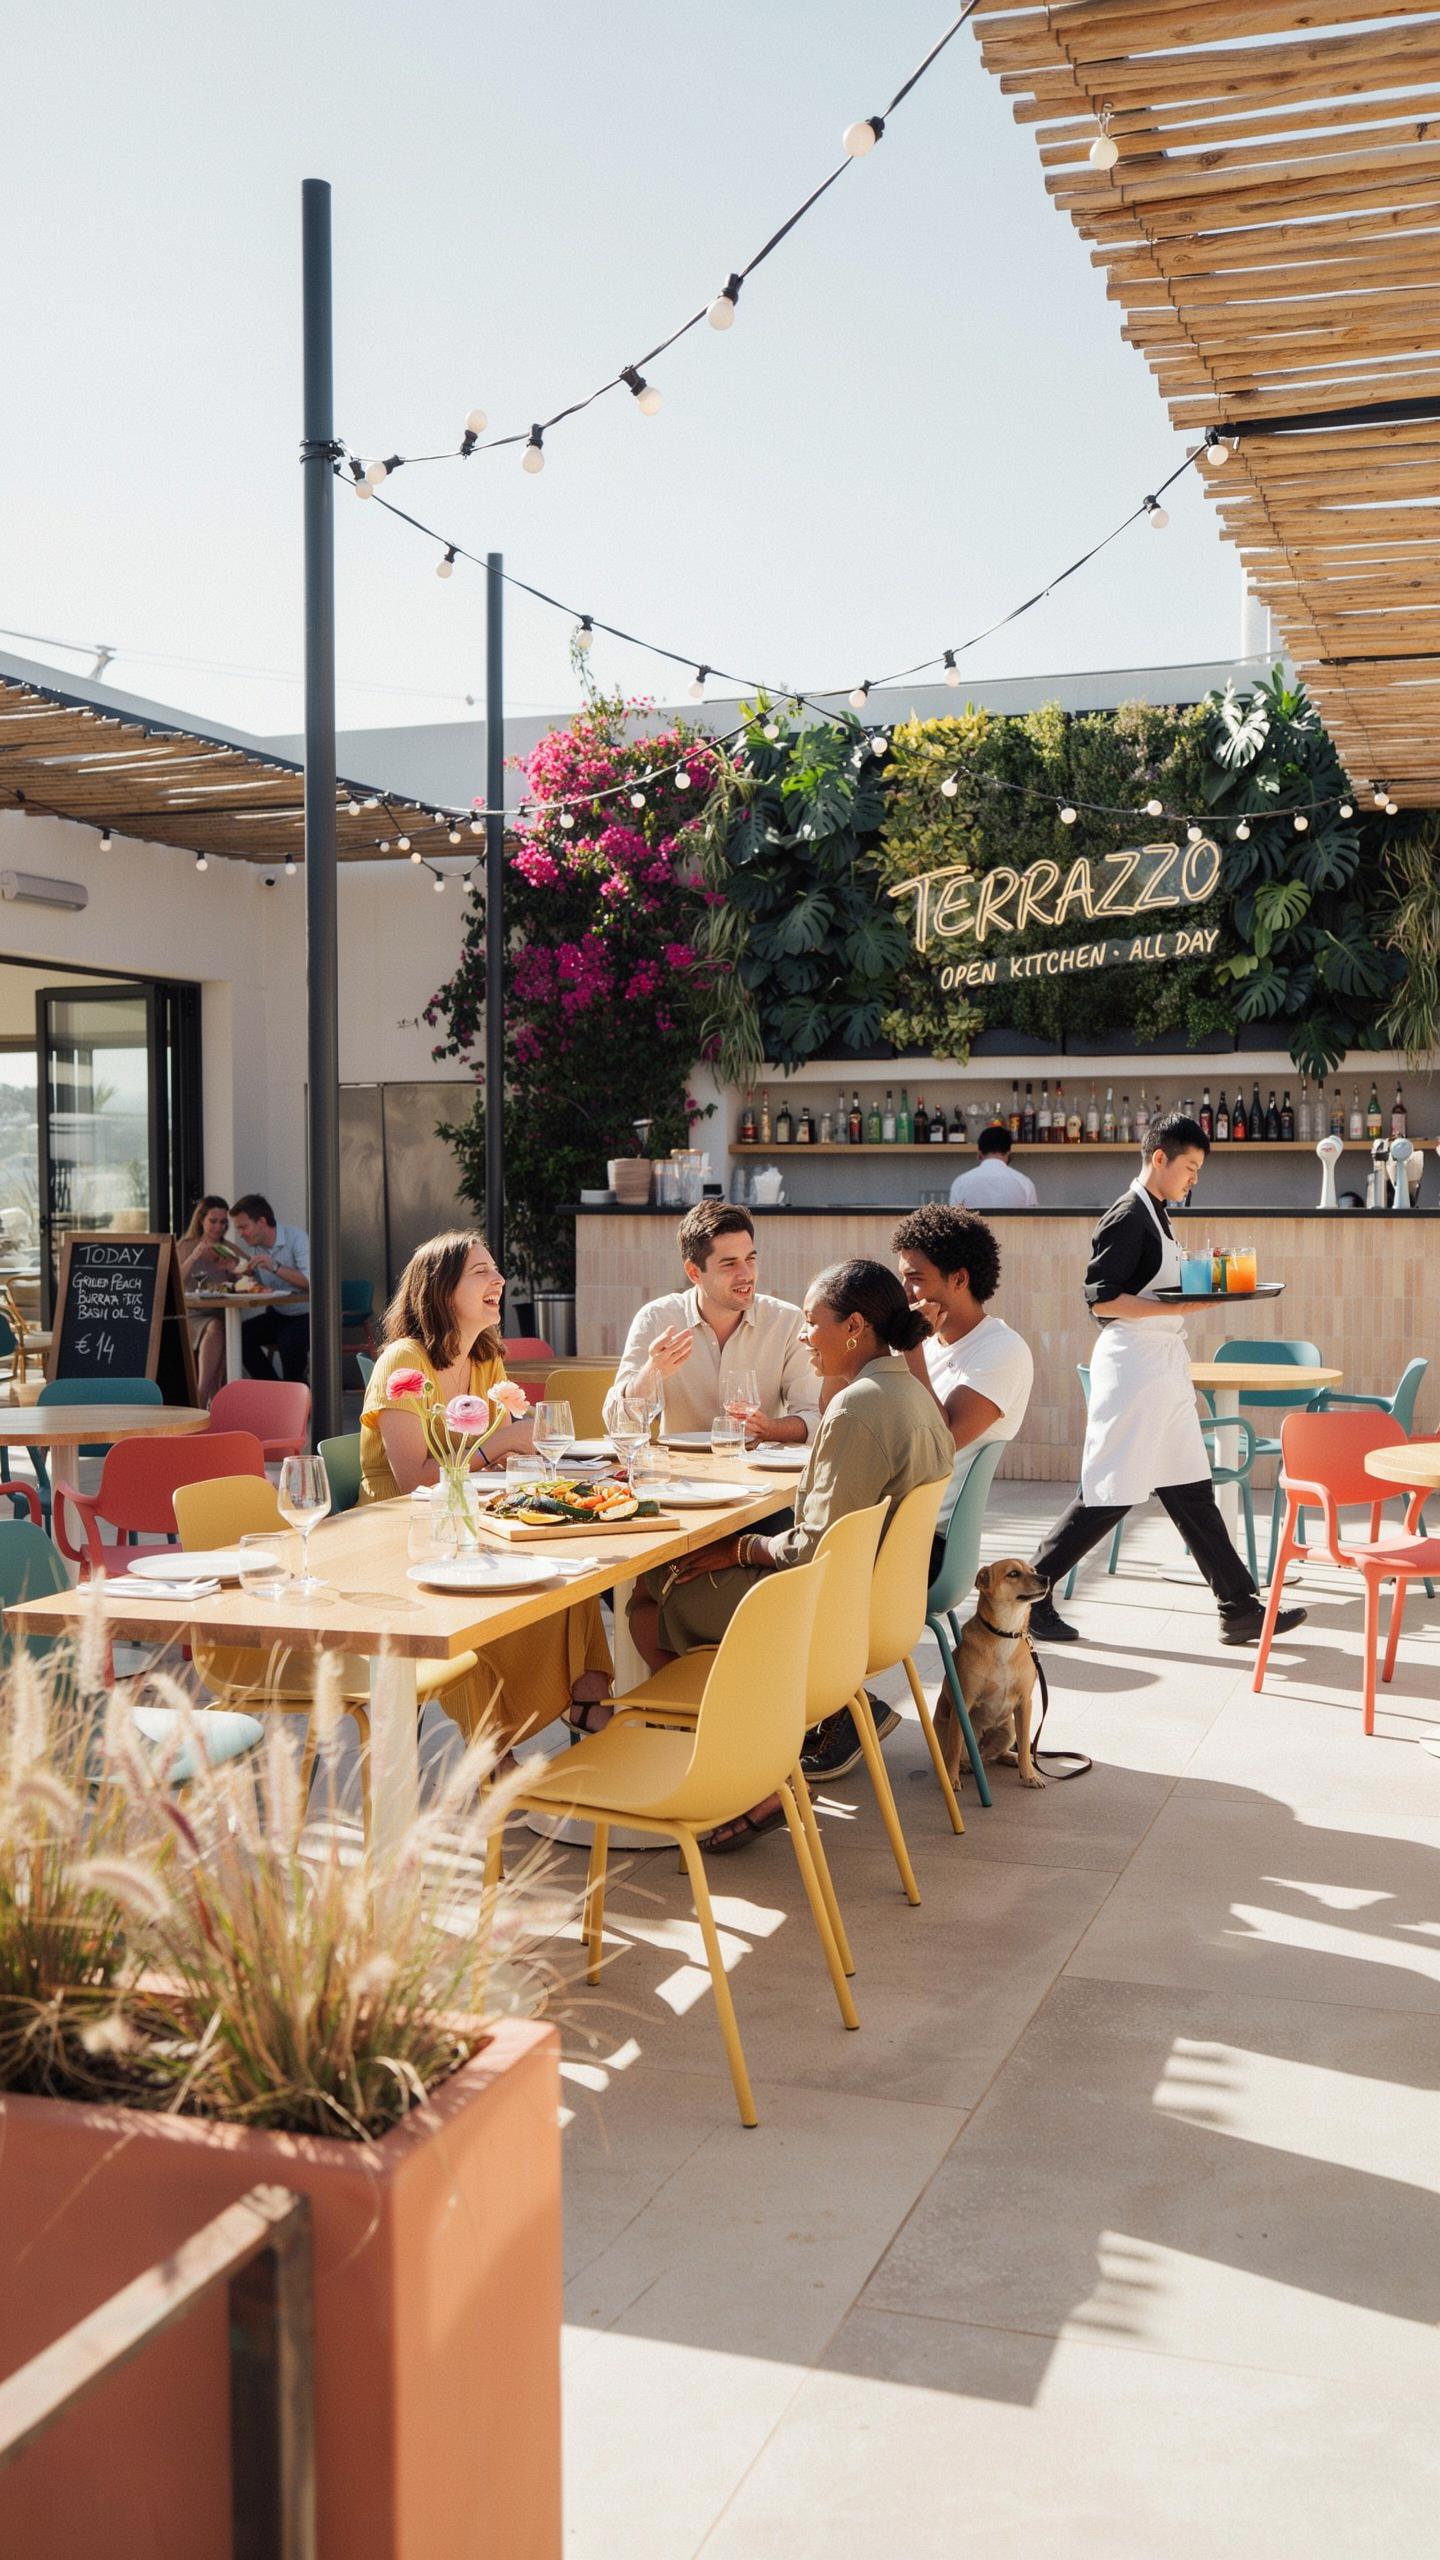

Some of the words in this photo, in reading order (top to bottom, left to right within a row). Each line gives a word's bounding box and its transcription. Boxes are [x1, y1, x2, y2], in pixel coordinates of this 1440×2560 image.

[887, 839, 1221, 953] TERRAZZO
[940, 962, 997, 990] OPEN
[1009, 943, 1106, 978] KITCHEN
[1129, 934, 1165, 960] ALL
[1175, 928, 1220, 955] DAY
[80, 1244, 144, 1265] TODAY
[110, 1273, 142, 1291] PEACH
